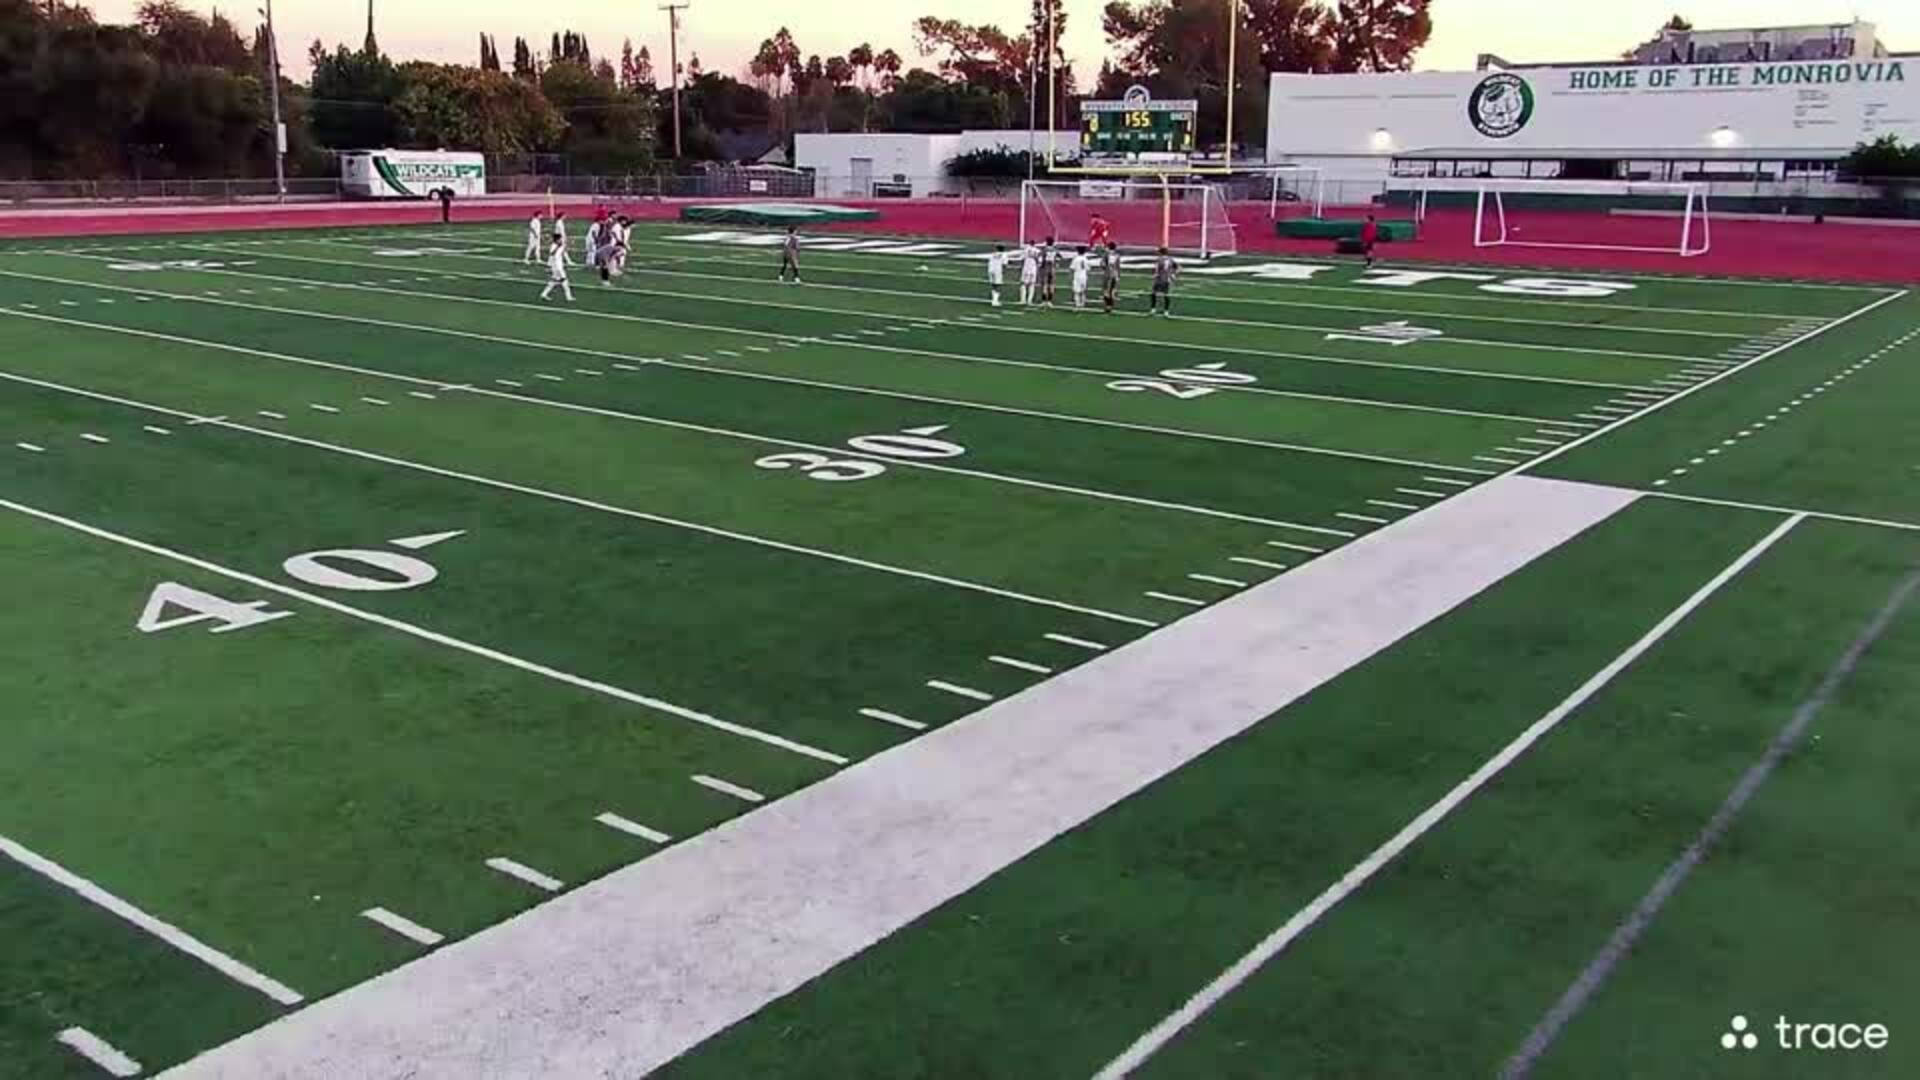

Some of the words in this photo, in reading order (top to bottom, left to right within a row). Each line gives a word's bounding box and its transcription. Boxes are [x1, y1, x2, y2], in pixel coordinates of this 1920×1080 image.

[1568, 69, 1638, 89] HOME
[1647, 67, 1679, 87] OF
[1691, 66, 1741, 86] THE
[1751, 62, 1905, 85] MONROVIA
[1105, 368, 1258, 398] 20
[754, 434, 965, 481] 30
[136, 549, 438, 632] 40
